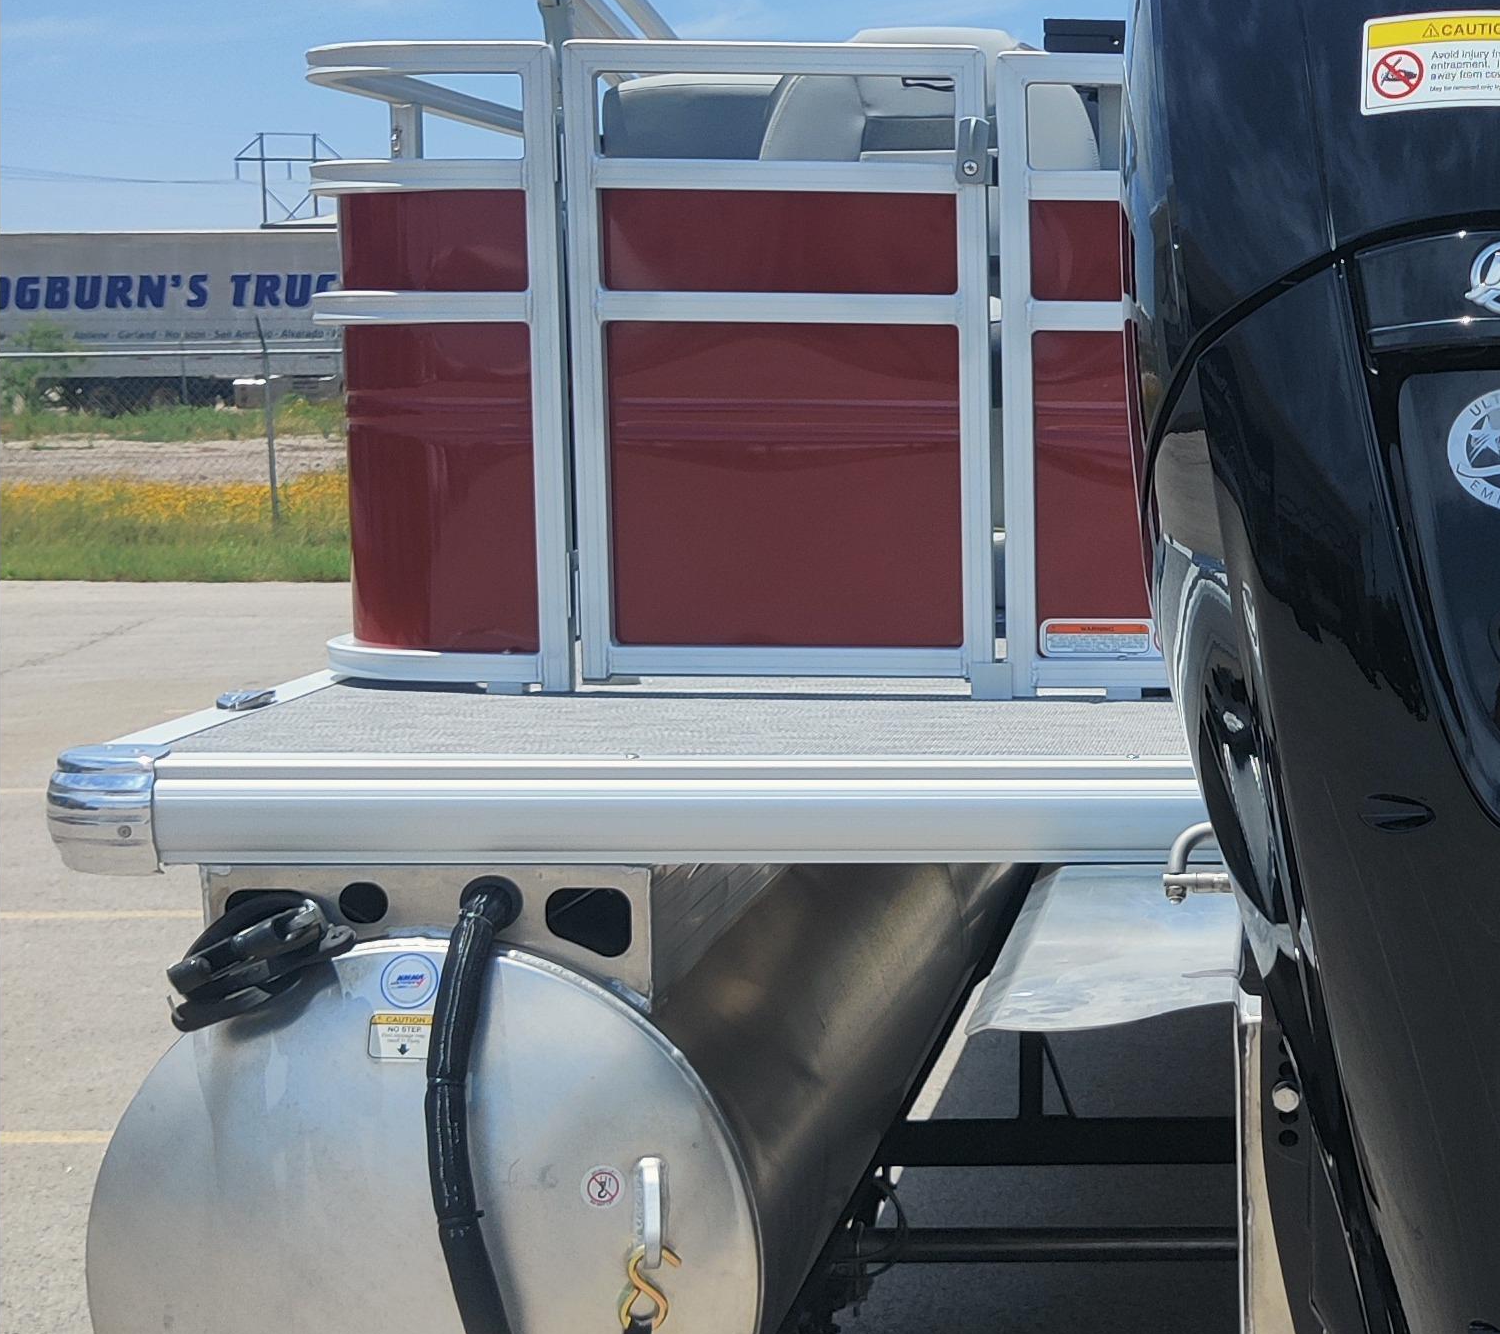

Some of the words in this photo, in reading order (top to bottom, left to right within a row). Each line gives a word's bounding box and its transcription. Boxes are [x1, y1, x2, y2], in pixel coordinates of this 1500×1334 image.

[1431, 51, 1459, 60] Avoid
[1462, 50, 1489, 61] injury
[1430, 60, 1491, 70] entrapment.
[1430, 71, 1457, 81] away
[1460, 70, 1482, 80] from
